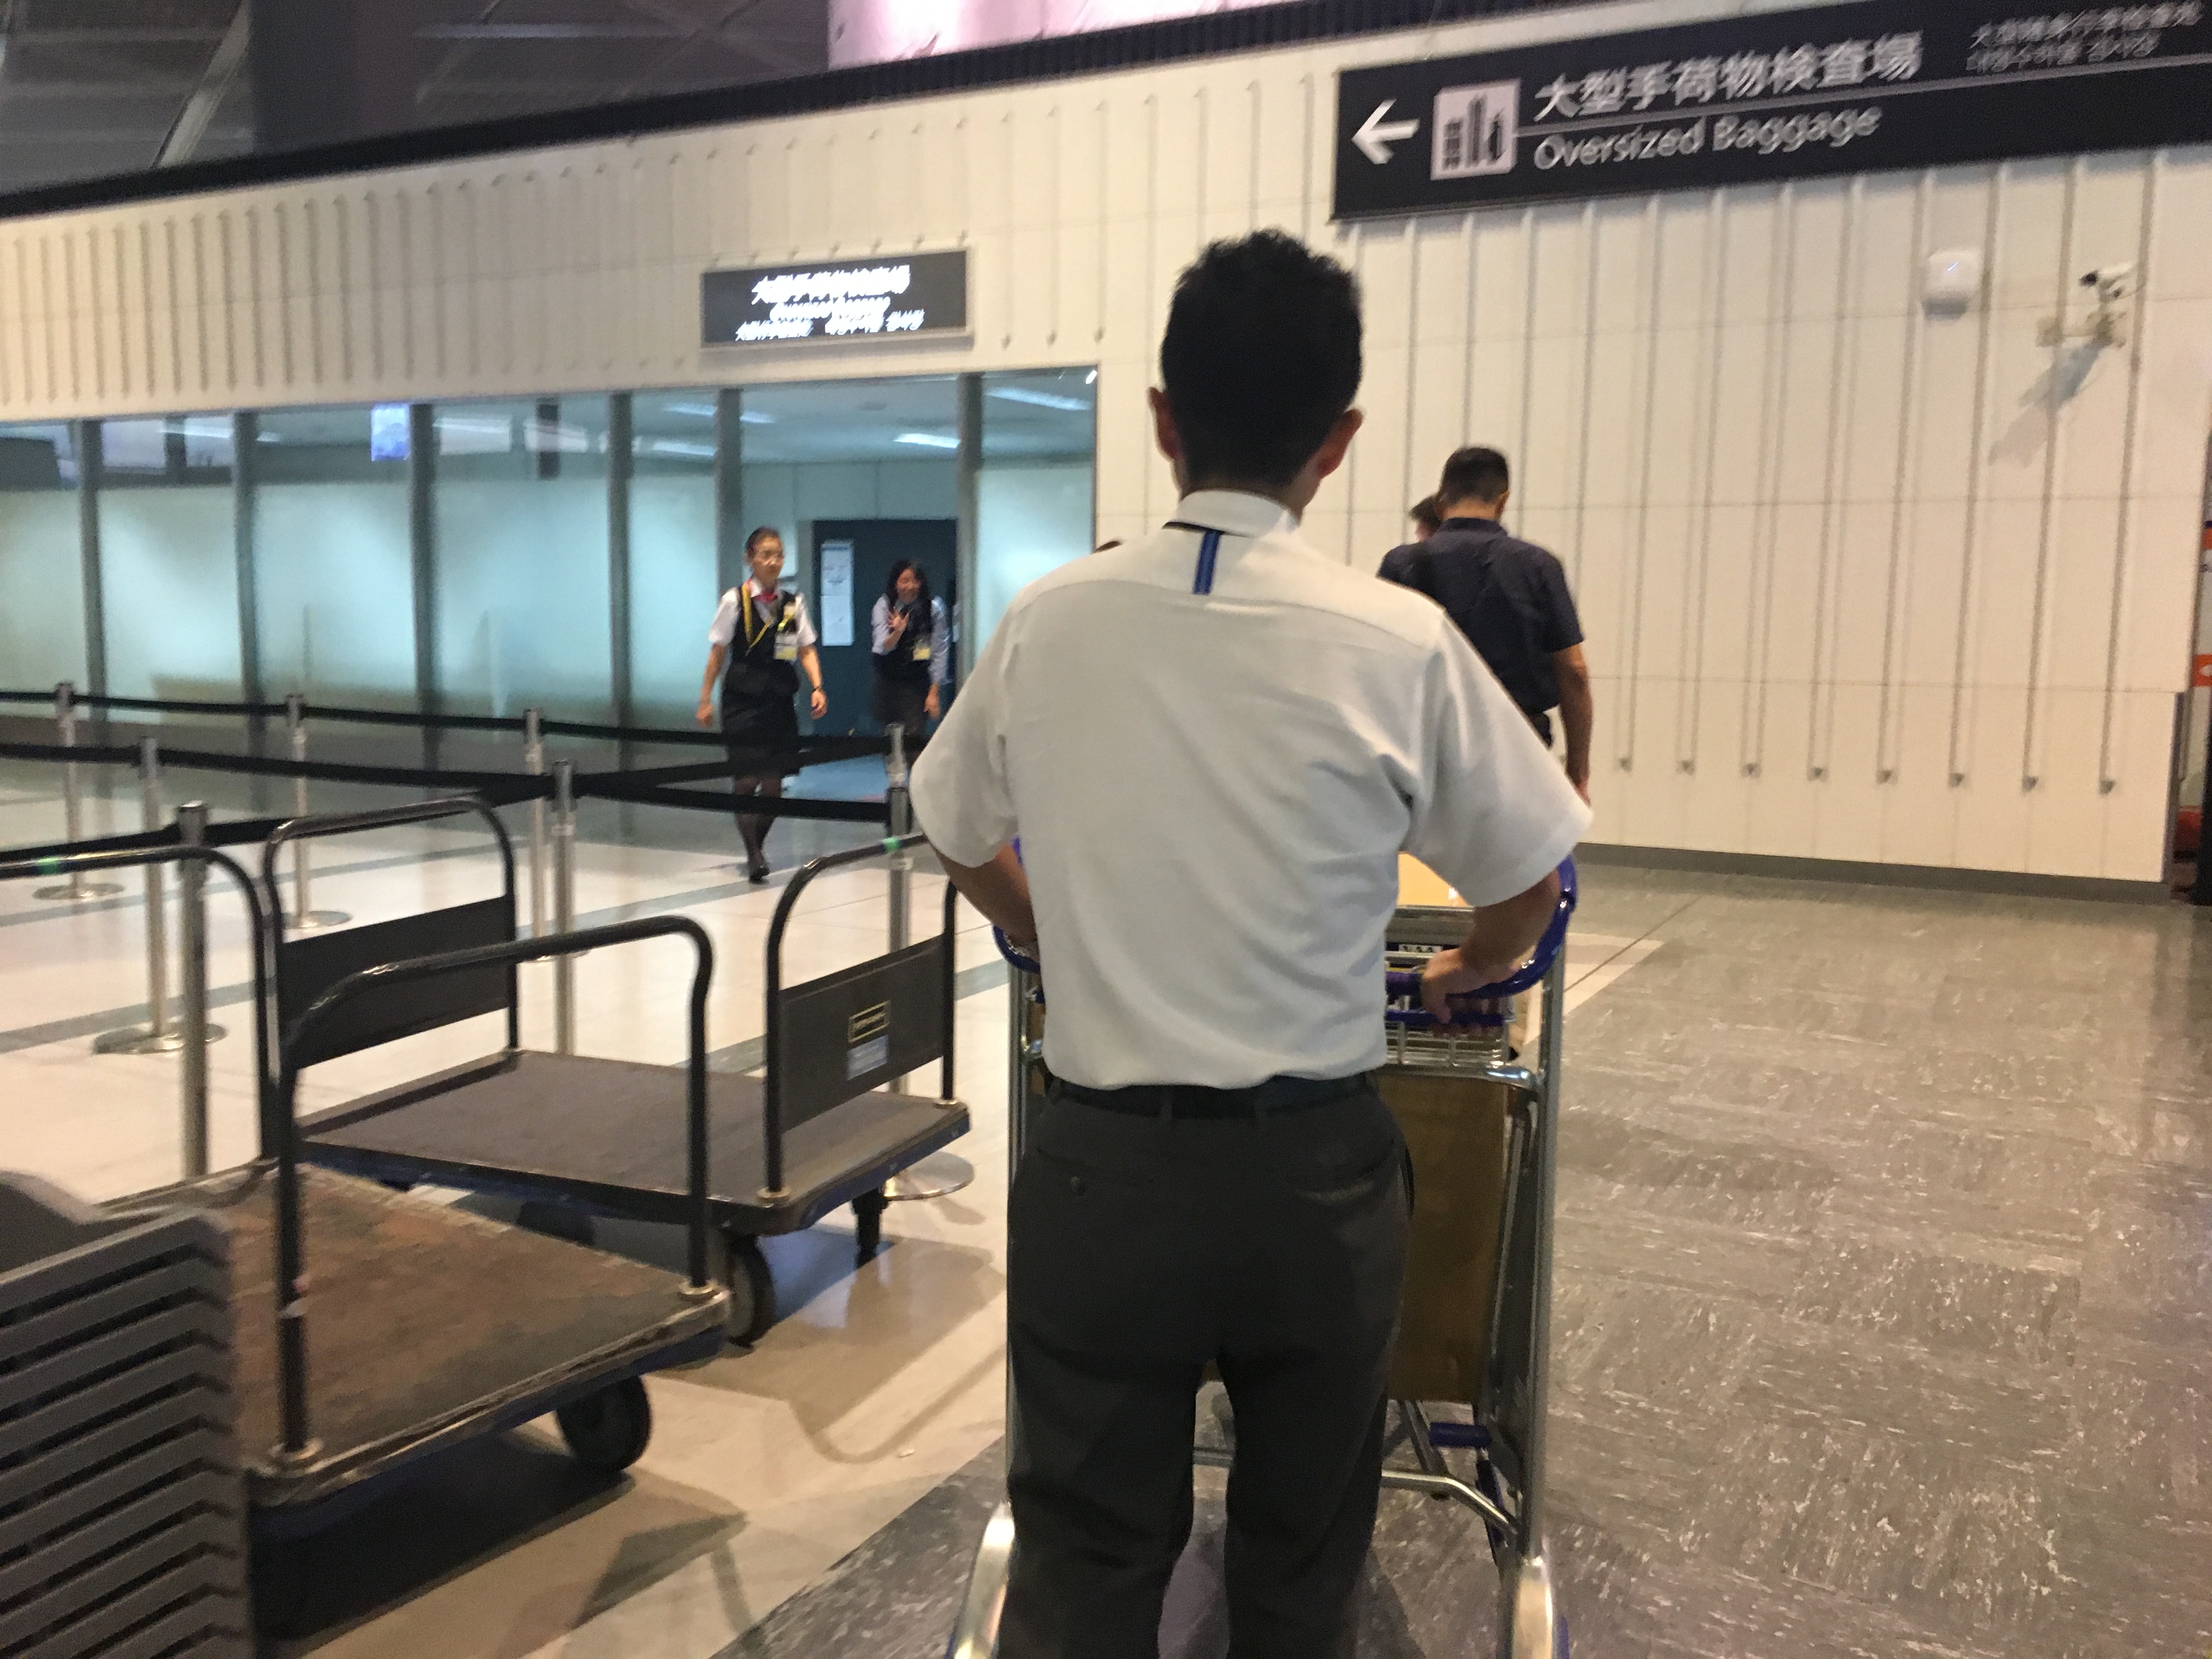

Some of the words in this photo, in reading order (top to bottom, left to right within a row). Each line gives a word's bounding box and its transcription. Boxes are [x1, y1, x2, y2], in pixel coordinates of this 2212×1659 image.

[1534, 31, 1923, 121] 大型手荷物検査場
[1534, 117, 1706, 170] Oversized
[1712, 107, 1882, 155] Baggage
